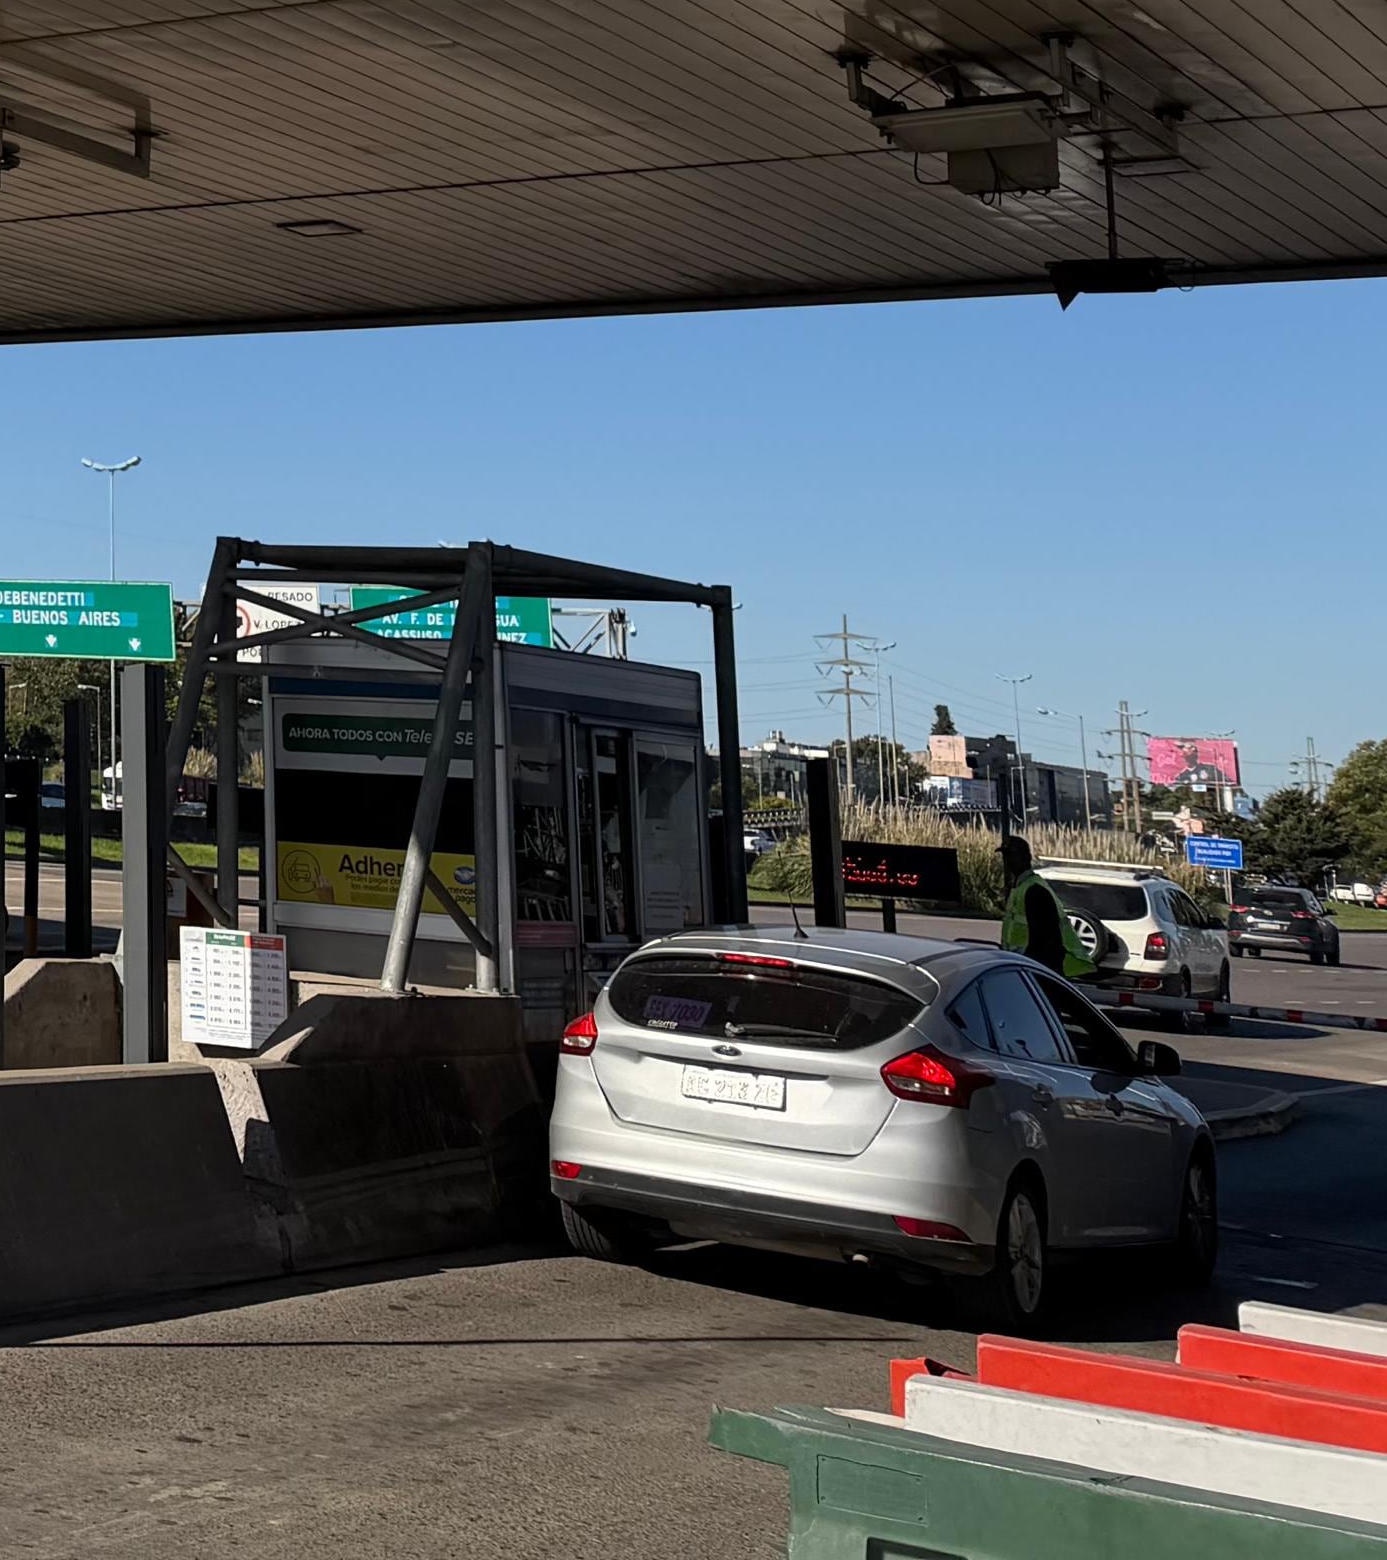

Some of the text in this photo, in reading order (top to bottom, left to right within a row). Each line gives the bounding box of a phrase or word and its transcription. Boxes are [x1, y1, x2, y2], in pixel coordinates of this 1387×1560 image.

[12, 609, 68, 625] BUENOS
[78, 611, 121, 627] AIRES
[382, 614, 402, 625] AV.
[427, 614, 444, 625] DE
[289, 727, 330, 739] AHORA
[332, 729, 373, 741] TODOS
[375, 730, 402, 743] CON
[338, 854, 405, 877] Adher
